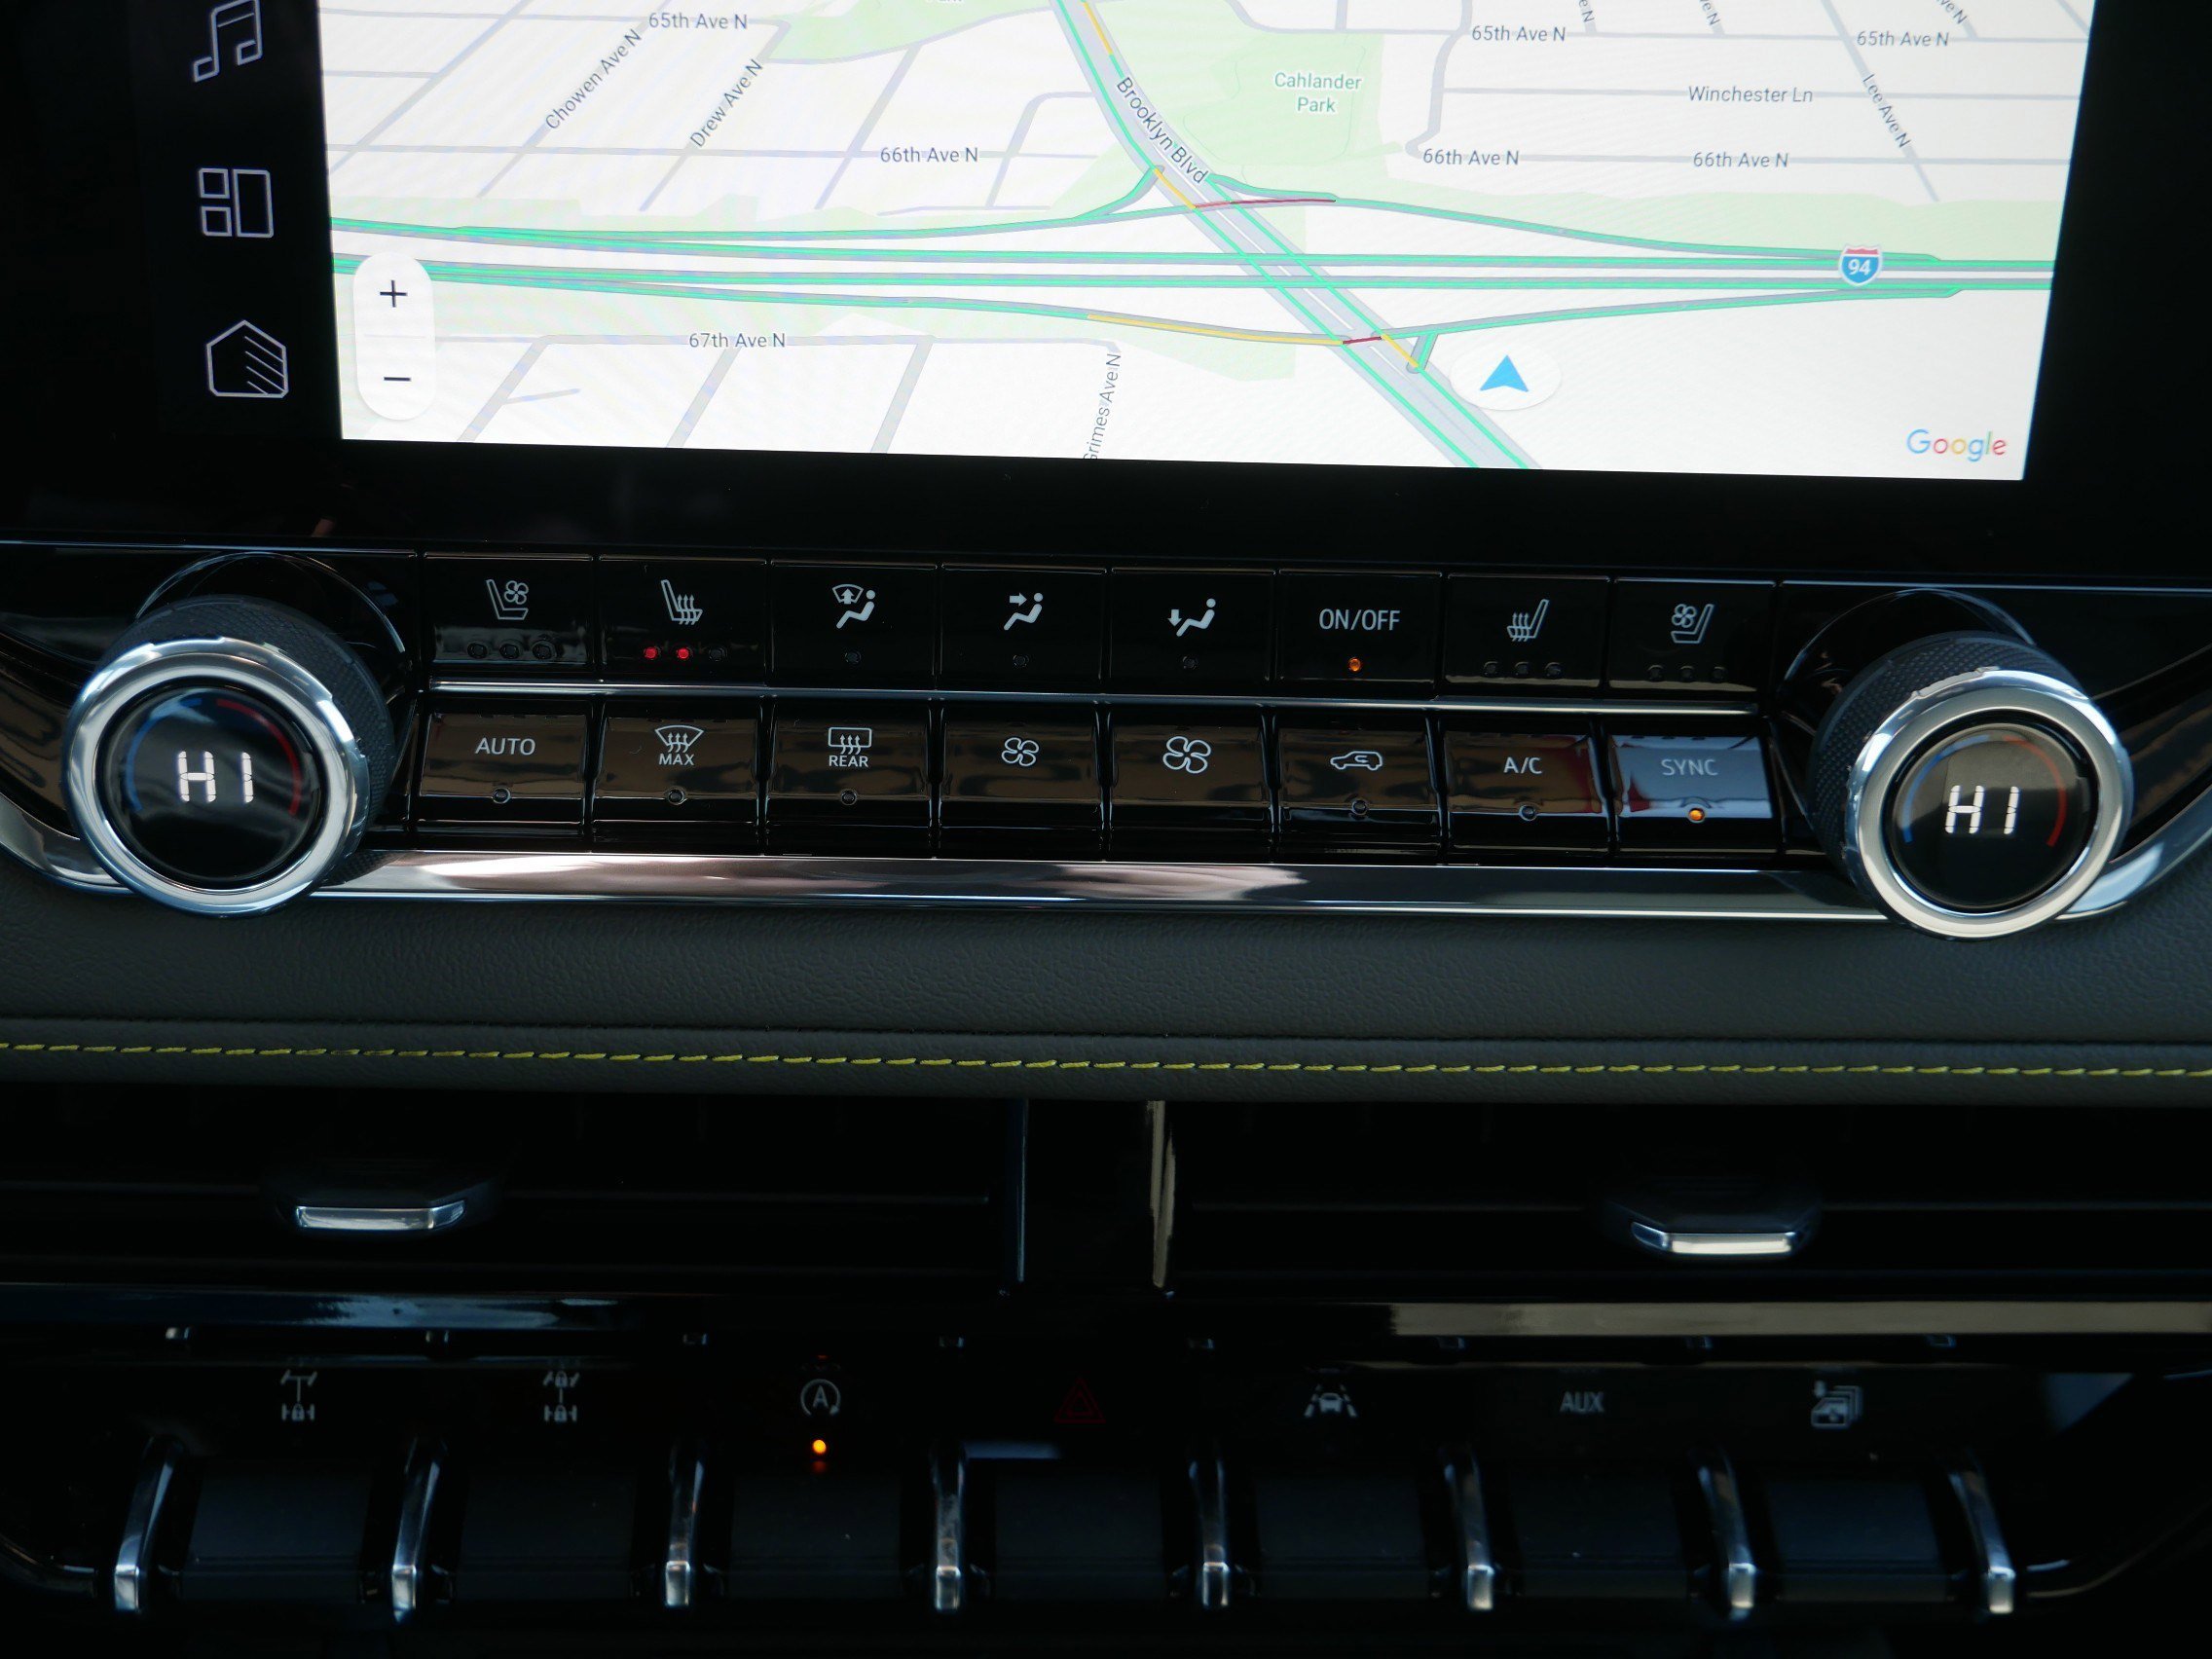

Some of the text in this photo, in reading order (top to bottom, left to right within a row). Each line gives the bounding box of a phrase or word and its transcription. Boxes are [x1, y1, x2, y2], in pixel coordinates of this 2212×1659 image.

[648, 13, 748, 29] 65th Ave N
[1472, 25, 1567, 41] 65th Ave N
[1857, 30, 1949, 46] 65th Ave N
[545, 28, 643, 129] Chowen Ave N
[1274, 72, 1362, 90] Cahlander
[689, 58, 763, 148] Drew Ave N
[1688, 86, 1813, 102] Winchester Ln
[1297, 97, 1336, 113] Park
[1862, 73, 1911, 148] Lee Ave N
[1117, 77, 1210, 184] Brooklyn Blvd
[880, 146, 978, 163] 66th Ave N
[1422, 148, 1520, 166] 66th Ave N
[1693, 152, 1789, 167] 66th Ave N
[1847, 258, 1871, 276] 94
[688, 332, 786, 348] 67th Ave N
[1105, 353, 1122, 367] N
[1099, 371, 1119, 403] Ave
[1906, 428, 2008, 462] Google
[1318, 608, 1401, 631] ON/OFF
[475, 737, 536, 756] AUTO
[657, 752, 695, 767] MAX
[828, 754, 869, 768] REAR
[1503, 756, 1543, 775] A/C
[1661, 757, 1718, 777] SYNC
[1559, 1391, 1605, 1414] AUX
